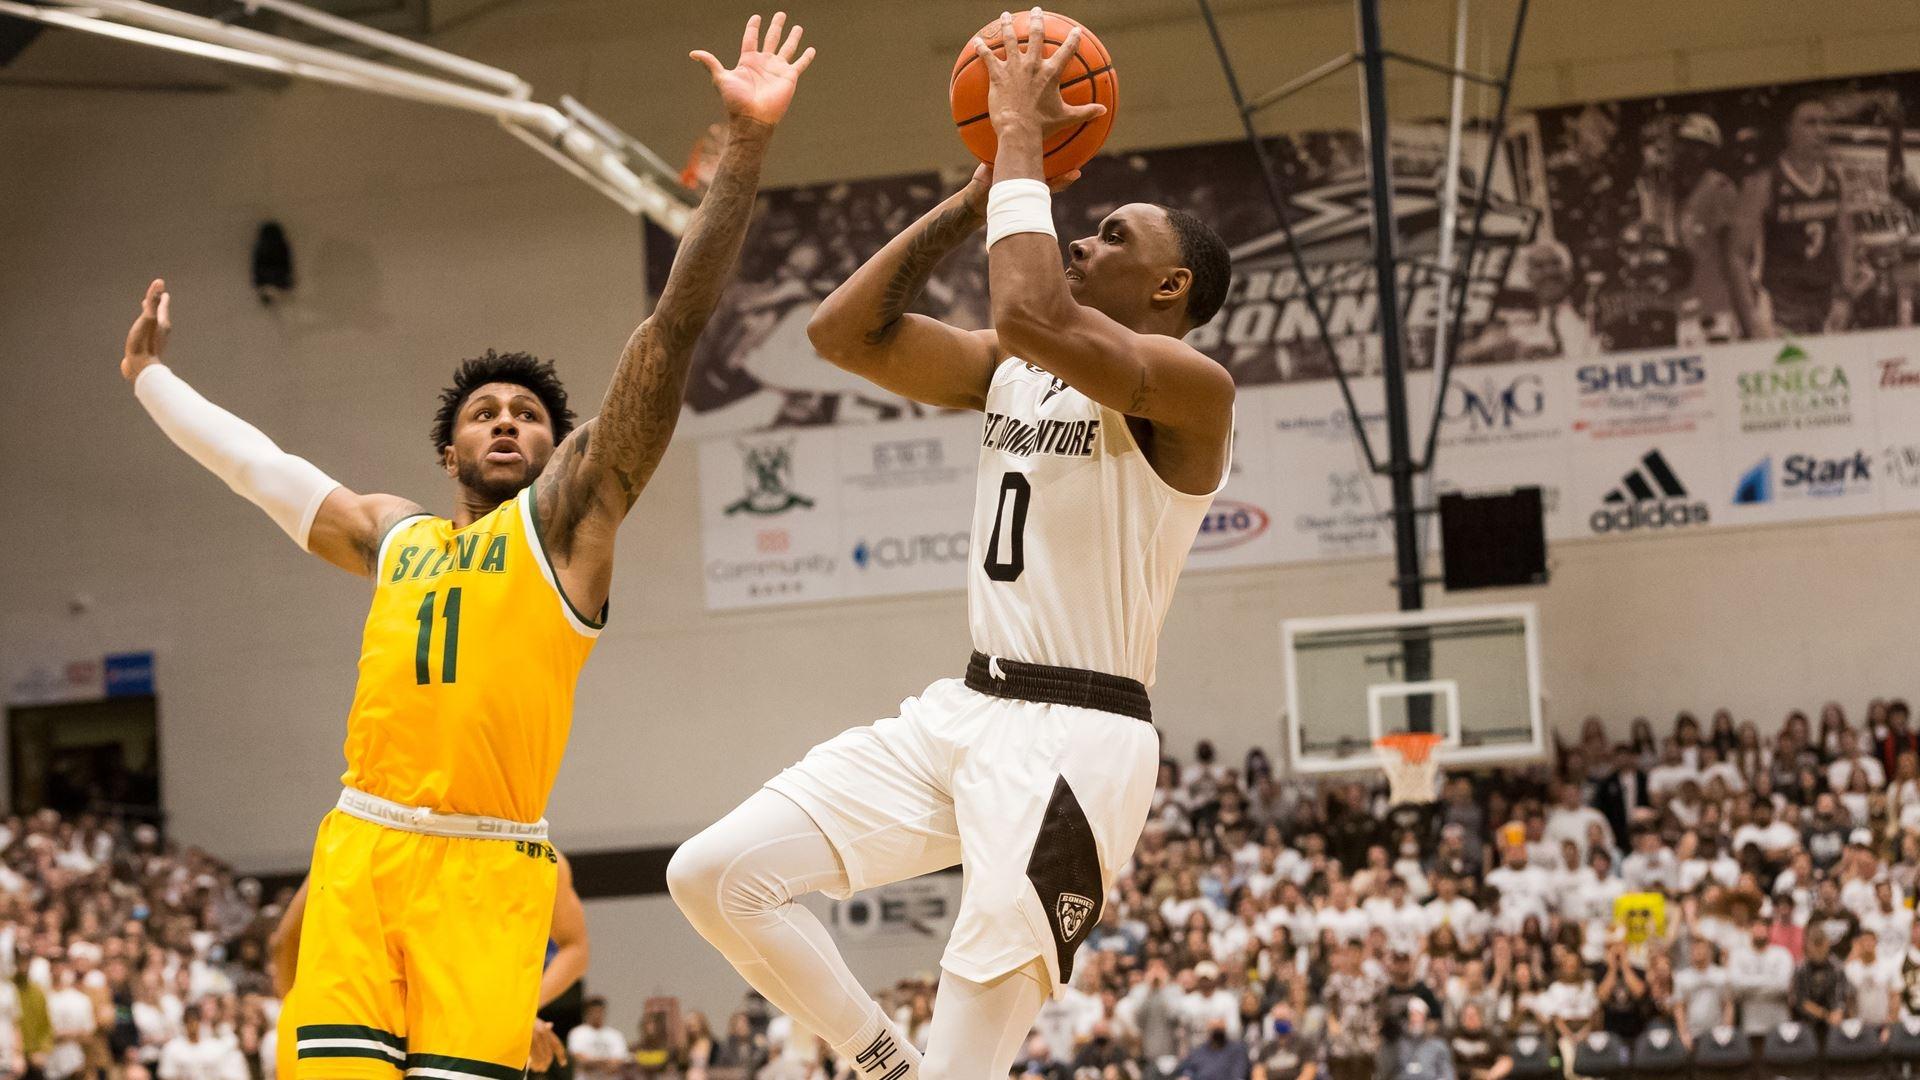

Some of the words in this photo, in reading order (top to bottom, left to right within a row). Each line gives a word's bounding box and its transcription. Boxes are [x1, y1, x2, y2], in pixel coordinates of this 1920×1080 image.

[1186, 281, 1500, 350] BONNES
[1576, 356, 1705, 393] SHULTS
[1737, 366, 1849, 394] SENECA
[1782, 449, 1872, 487] Stark
[984, 472, 1031, 582] 0
[1590, 501, 1711, 534] adidas
[391, 533, 509, 583] SIENA
[416, 586, 462, 685] 11
[1060, 894, 1094, 910] BONNIES
